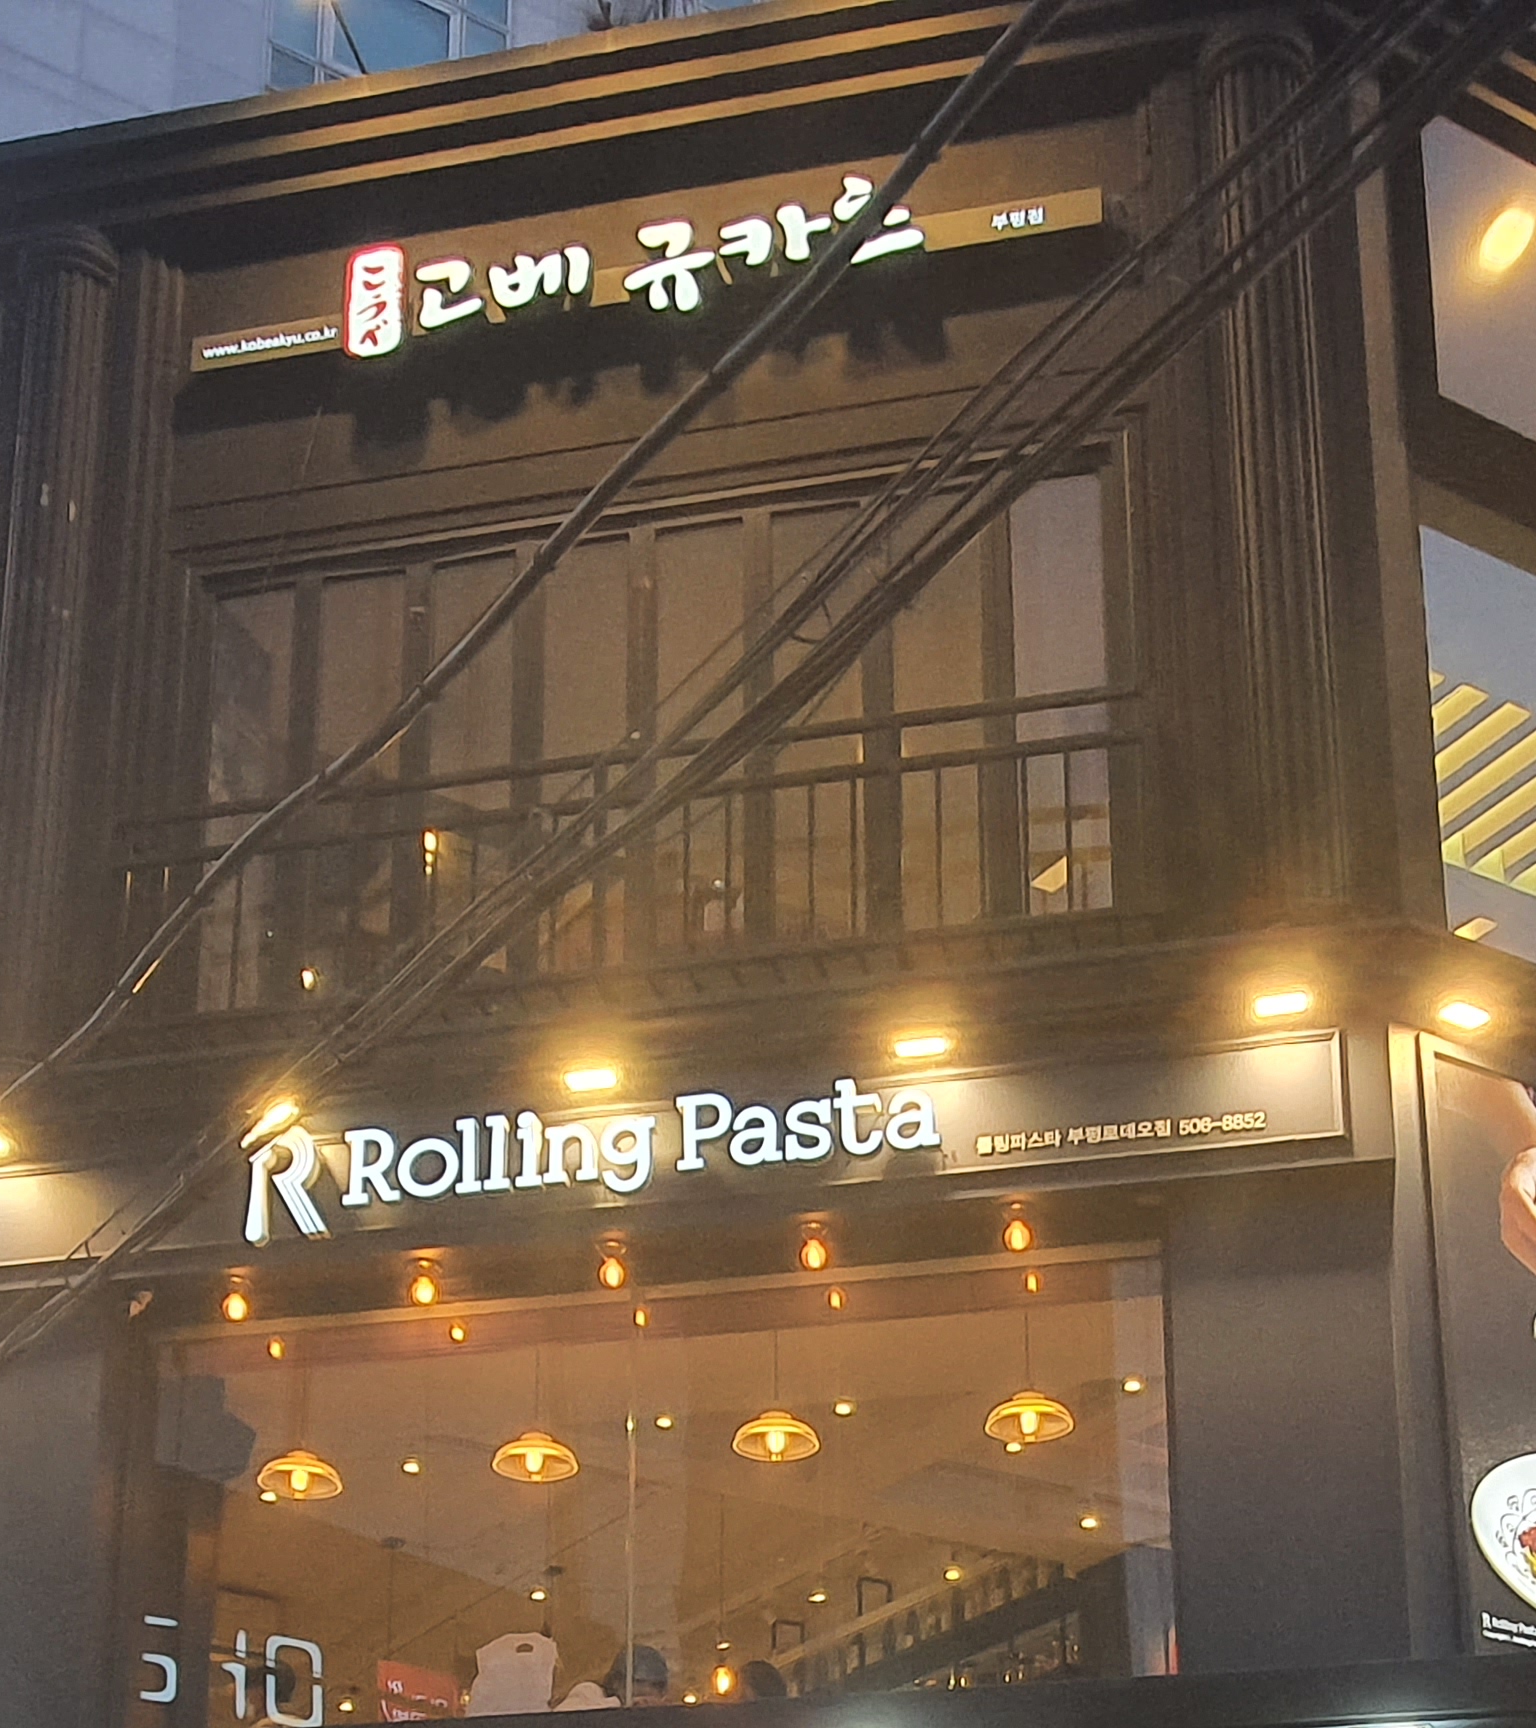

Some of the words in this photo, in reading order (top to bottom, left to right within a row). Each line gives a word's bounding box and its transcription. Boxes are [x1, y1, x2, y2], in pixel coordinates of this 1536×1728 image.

[414, 243, 594, 331] 고베
[623, 173, 925, 313] 규카츠
[342, 1112, 656, 1208] Rolling
[676, 1077, 941, 1172] Pasta
